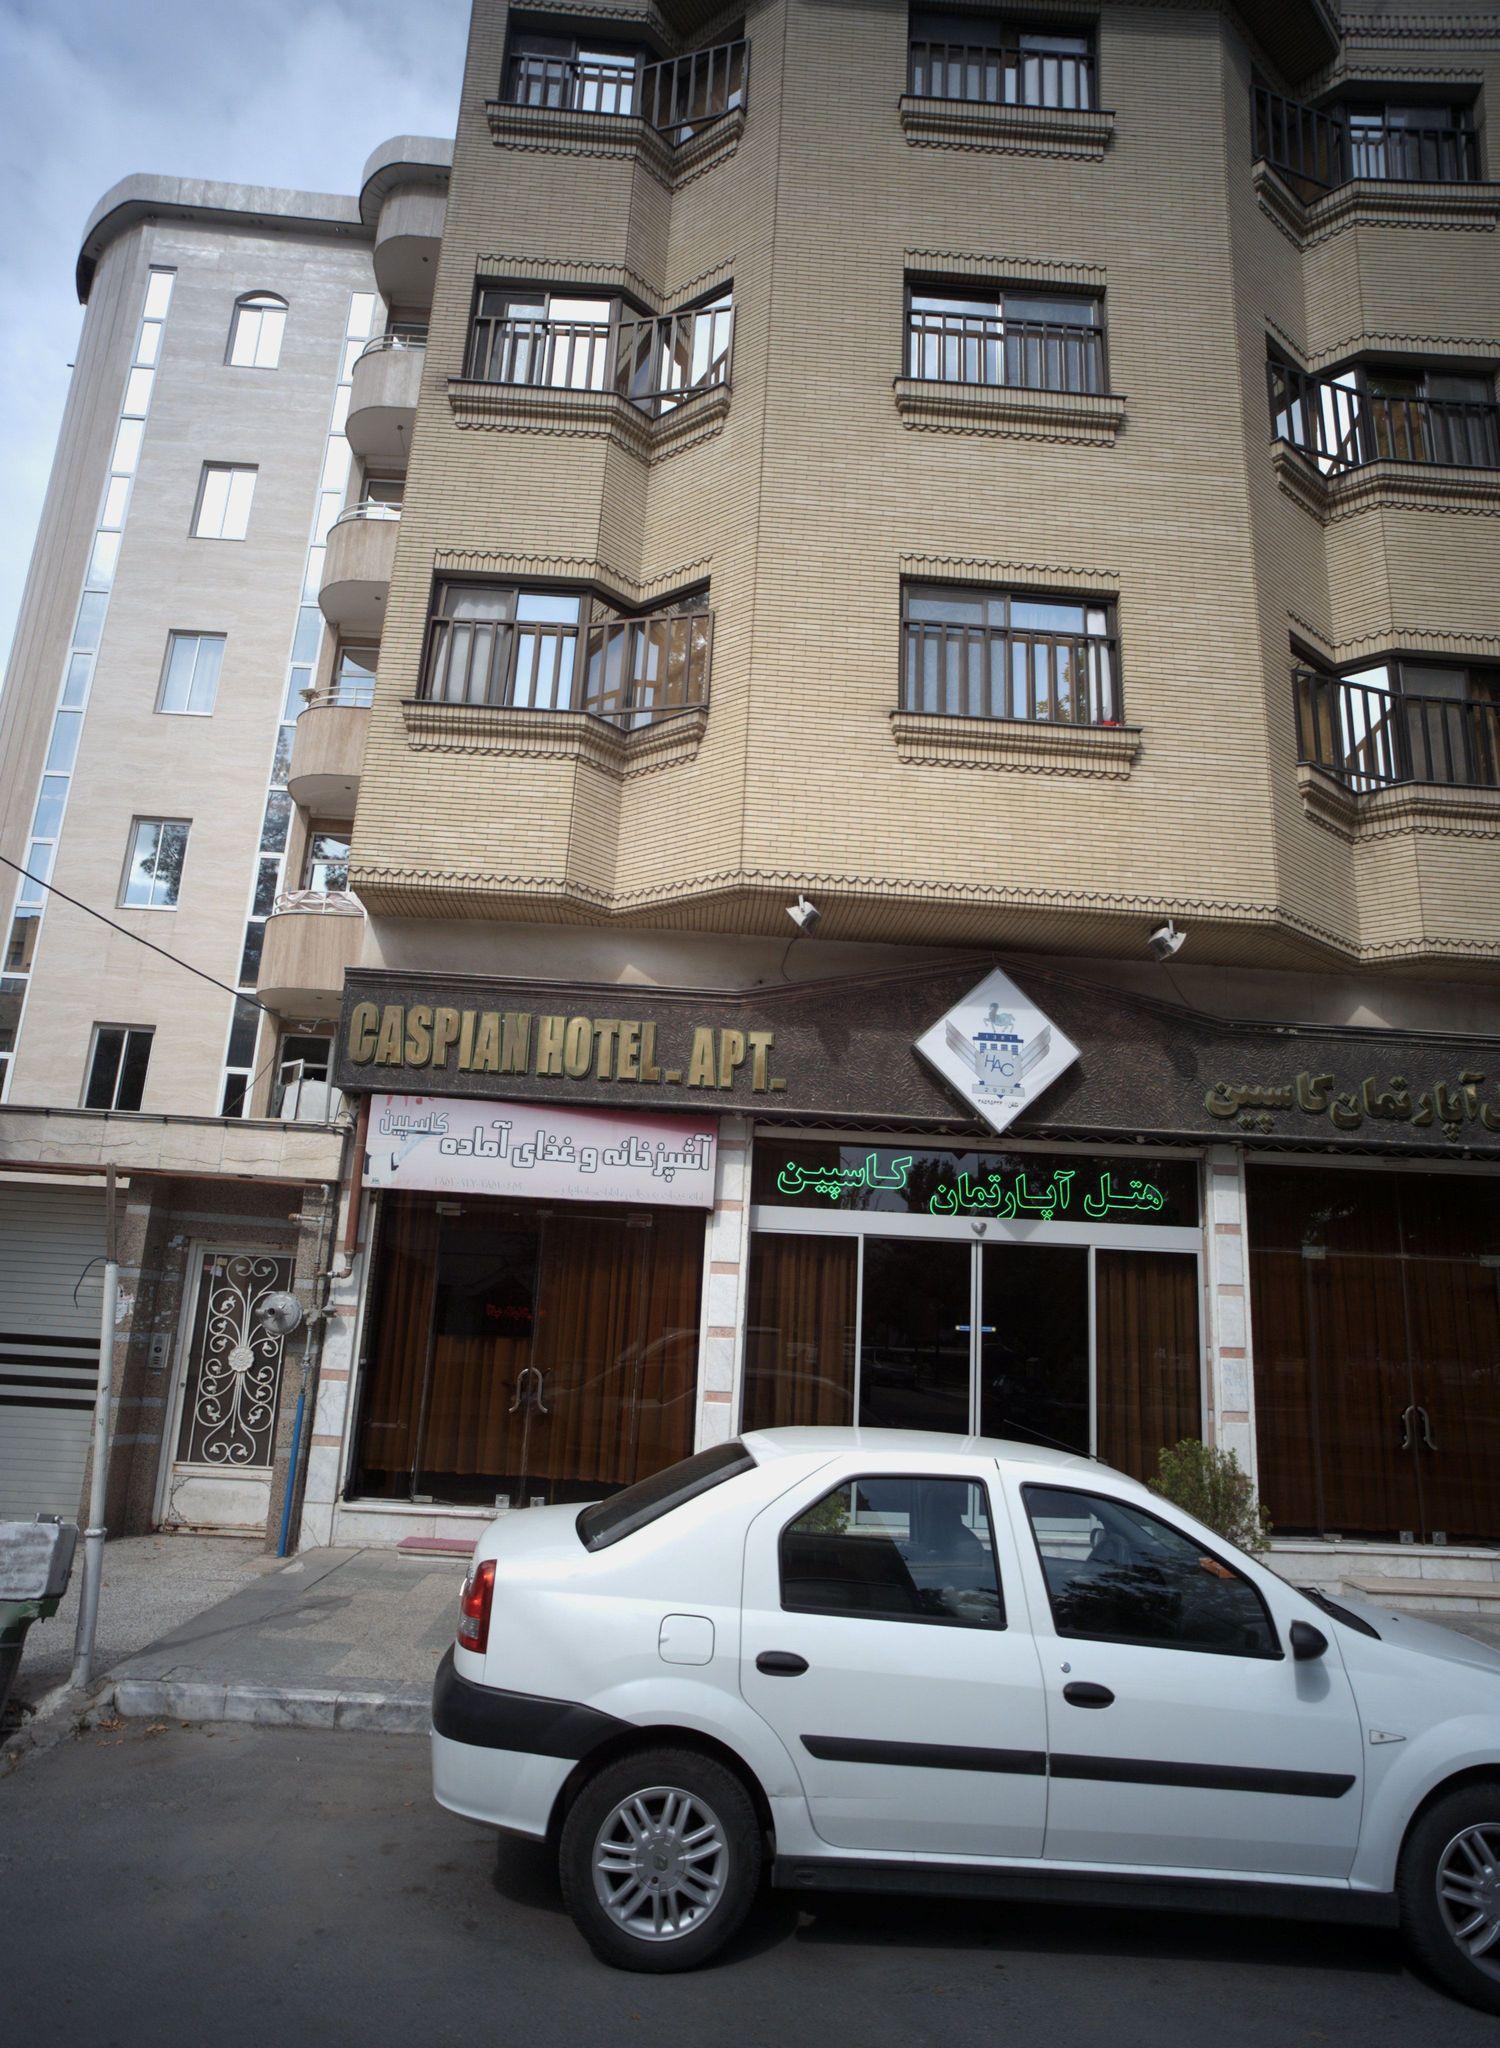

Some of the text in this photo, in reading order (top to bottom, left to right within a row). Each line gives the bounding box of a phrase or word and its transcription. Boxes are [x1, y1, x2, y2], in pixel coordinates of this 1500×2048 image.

[347, 1001, 532, 1075] CASPIAN
[984, 1054, 1014, 1077] HAC
[379, 1108, 449, 1141] کاسپین
[1205, 1071, 1335, 1134] کاسپین
[1330, 1071, 1486, 1143] آپارتمان
[440, 1120, 712, 1182] آشپزخانه و غذای آماده
[777, 1152, 1165, 1221] هتل آپارتمان کاسپین
